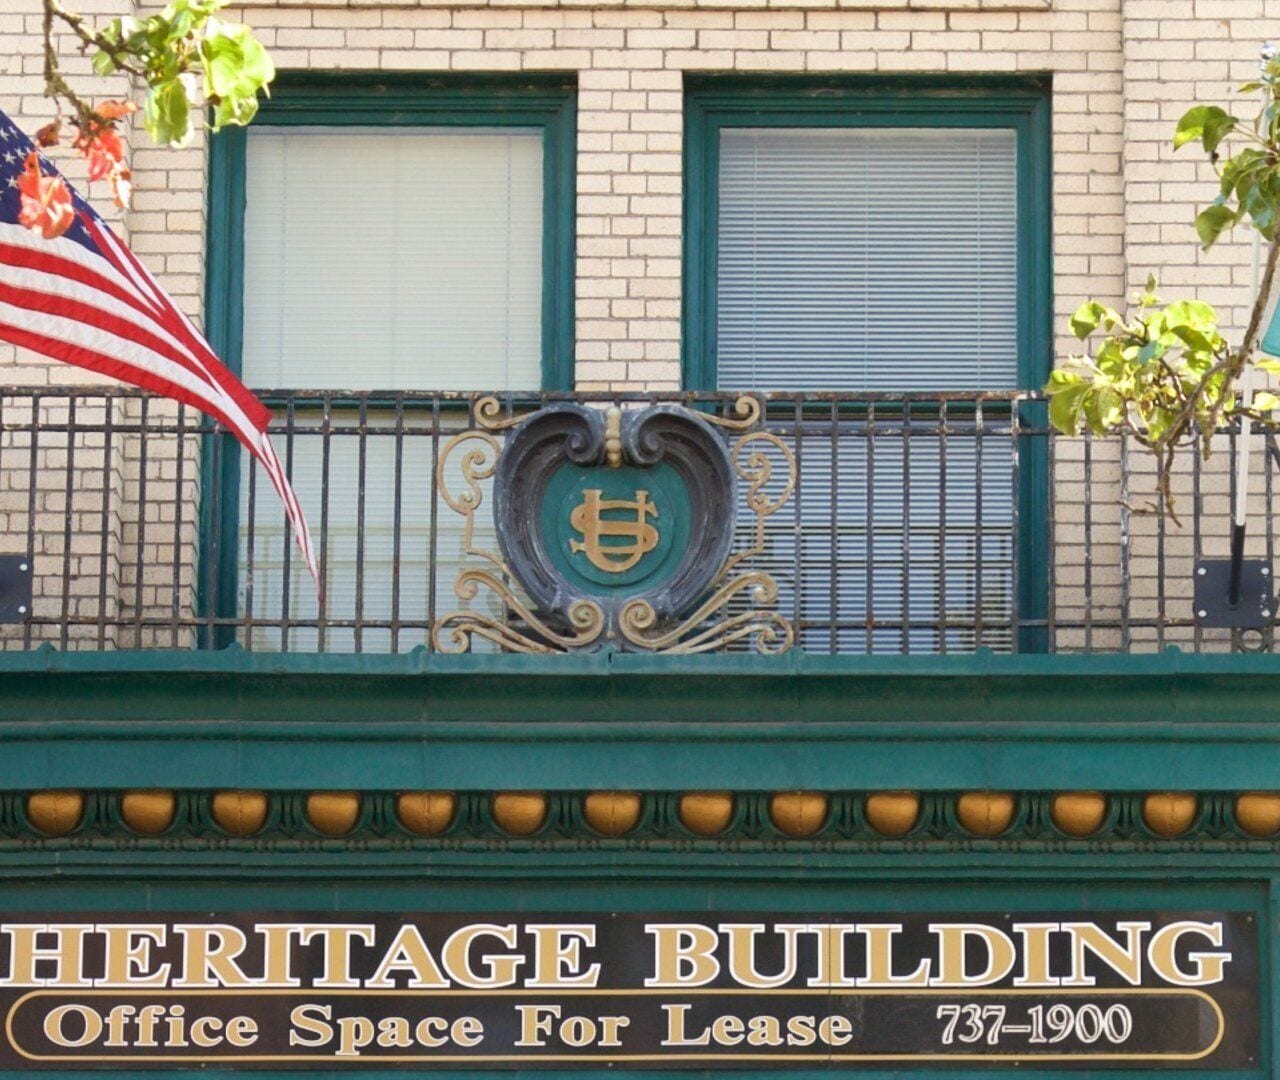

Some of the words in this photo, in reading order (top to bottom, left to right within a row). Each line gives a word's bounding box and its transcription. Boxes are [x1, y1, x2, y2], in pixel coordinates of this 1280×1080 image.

[643, 921, 1233, 988] BUILDING
[42, 1004, 260, 1047] Office
[288, 1004, 485, 1057] Space
[514, 1004, 630, 1047] For
[660, 1004, 854, 1047] Lease
[935, 1004, 1133, 1046] 737-1900
